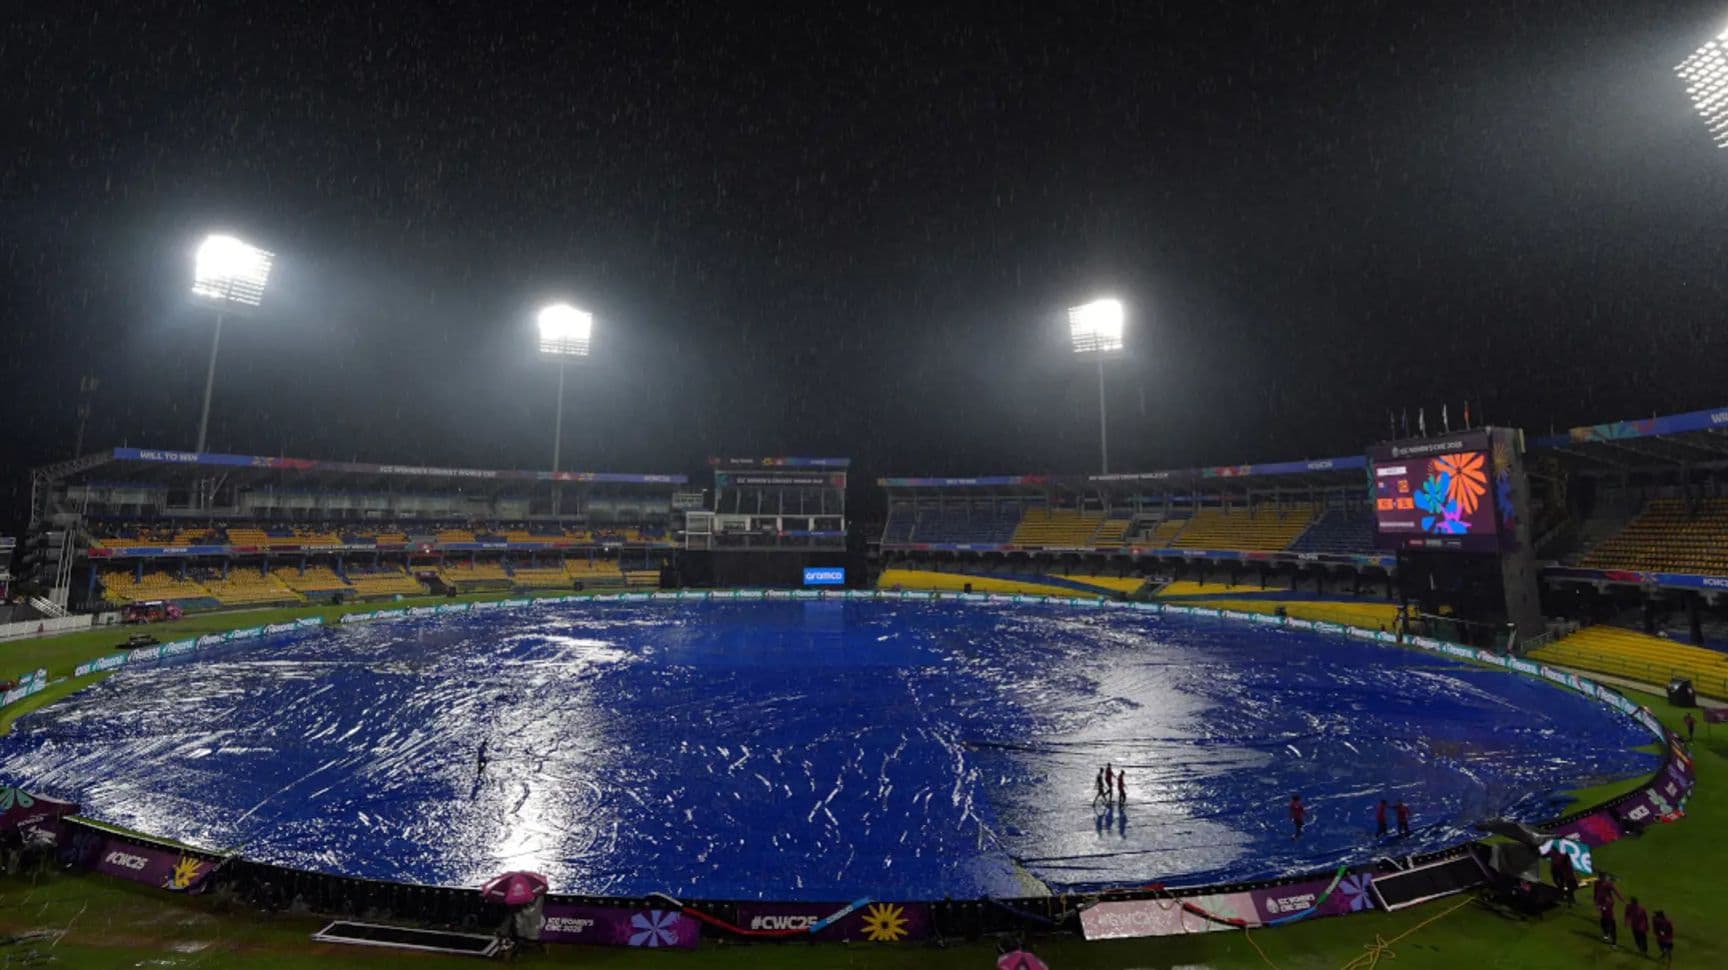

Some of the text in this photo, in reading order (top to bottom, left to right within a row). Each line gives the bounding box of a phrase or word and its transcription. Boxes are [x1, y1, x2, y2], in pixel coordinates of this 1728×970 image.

[140, 451, 198, 461] WILL TO WIN
[805, 572, 842, 580] aramco
[105, 852, 148, 870] #CWC25
[750, 916, 818, 930] #CWC25
